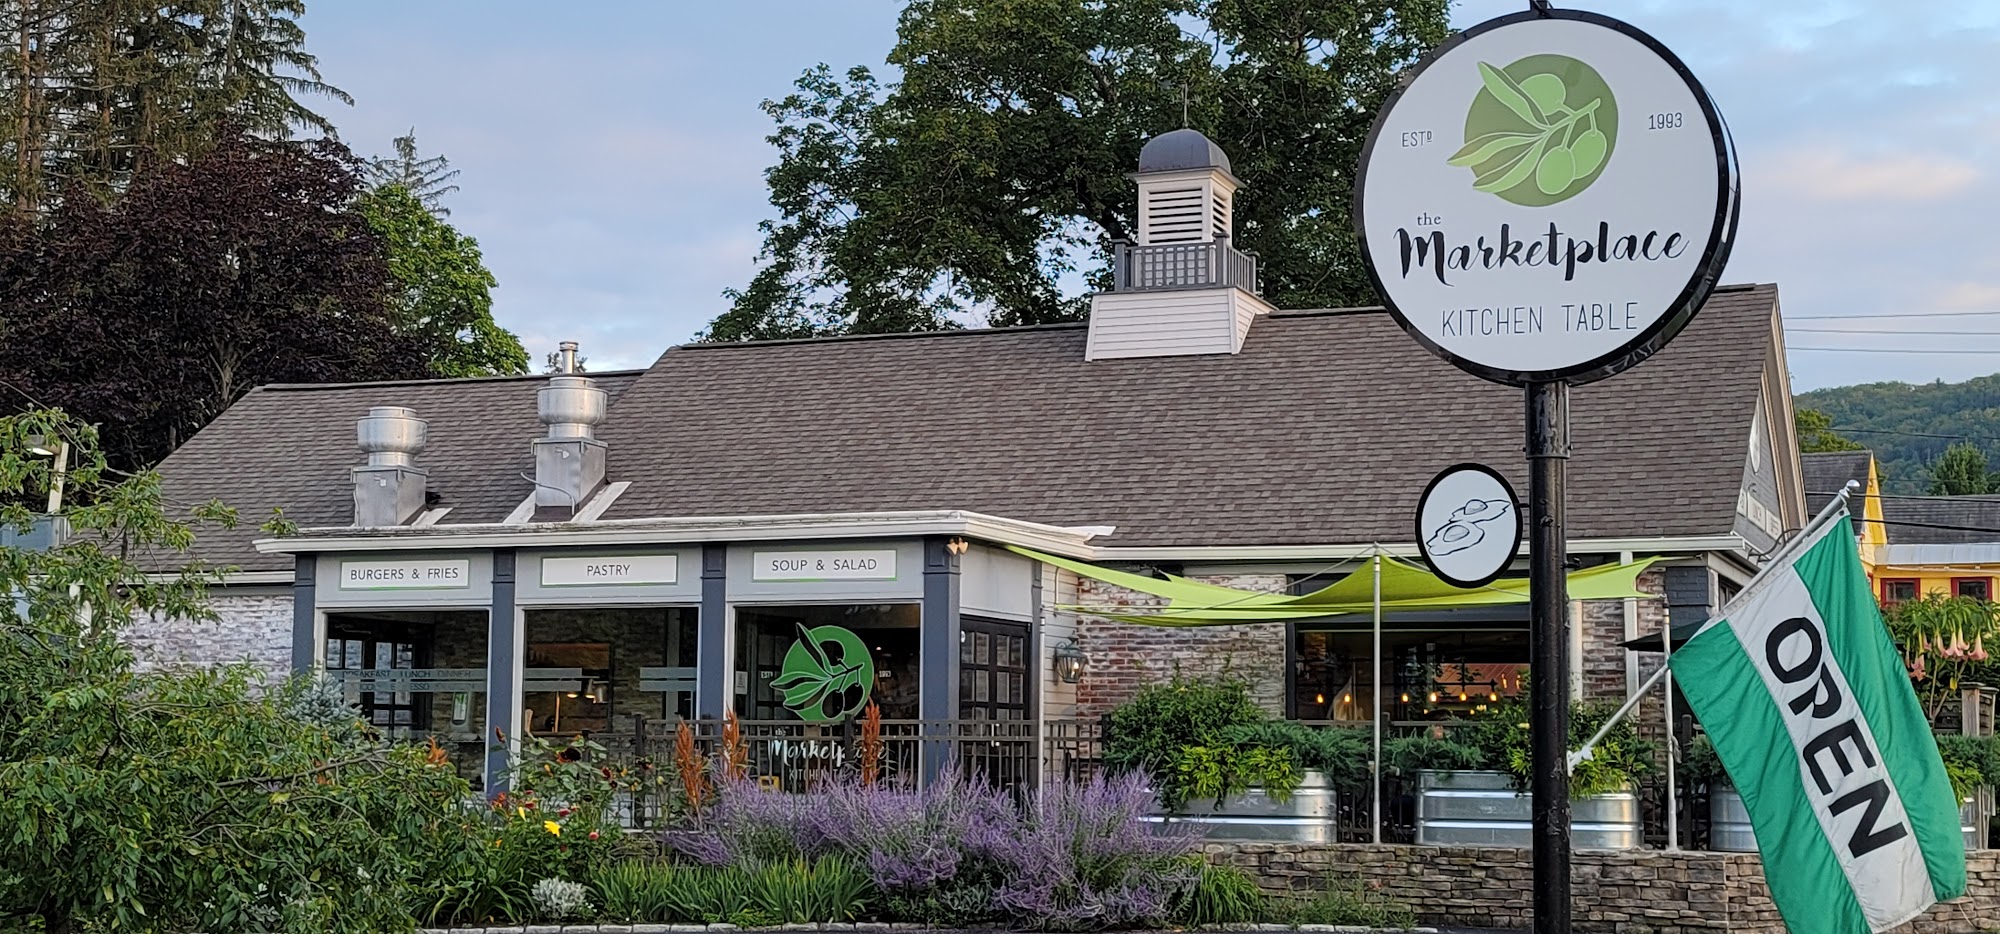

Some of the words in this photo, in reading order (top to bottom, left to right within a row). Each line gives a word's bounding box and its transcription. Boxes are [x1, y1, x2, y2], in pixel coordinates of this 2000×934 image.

[1648, 112, 1683, 130] 1993
[1417, 212, 1441, 226] the
[1393, 221, 1690, 287] Marketplace
[1442, 306, 1543, 337] KITCHEN
[1561, 302, 1638, 332] TABLE
[586, 564, 631, 577] PASTRY
[771, 559, 808, 572] SOUP
[815, 559, 825, 571] &
[833, 558, 877, 571] SALAD
[350, 568, 404, 581] BURGERS
[411, 568, 421, 580] &
[427, 567, 459, 579] FRIES
[1765, 617, 1908, 859] OPEN
